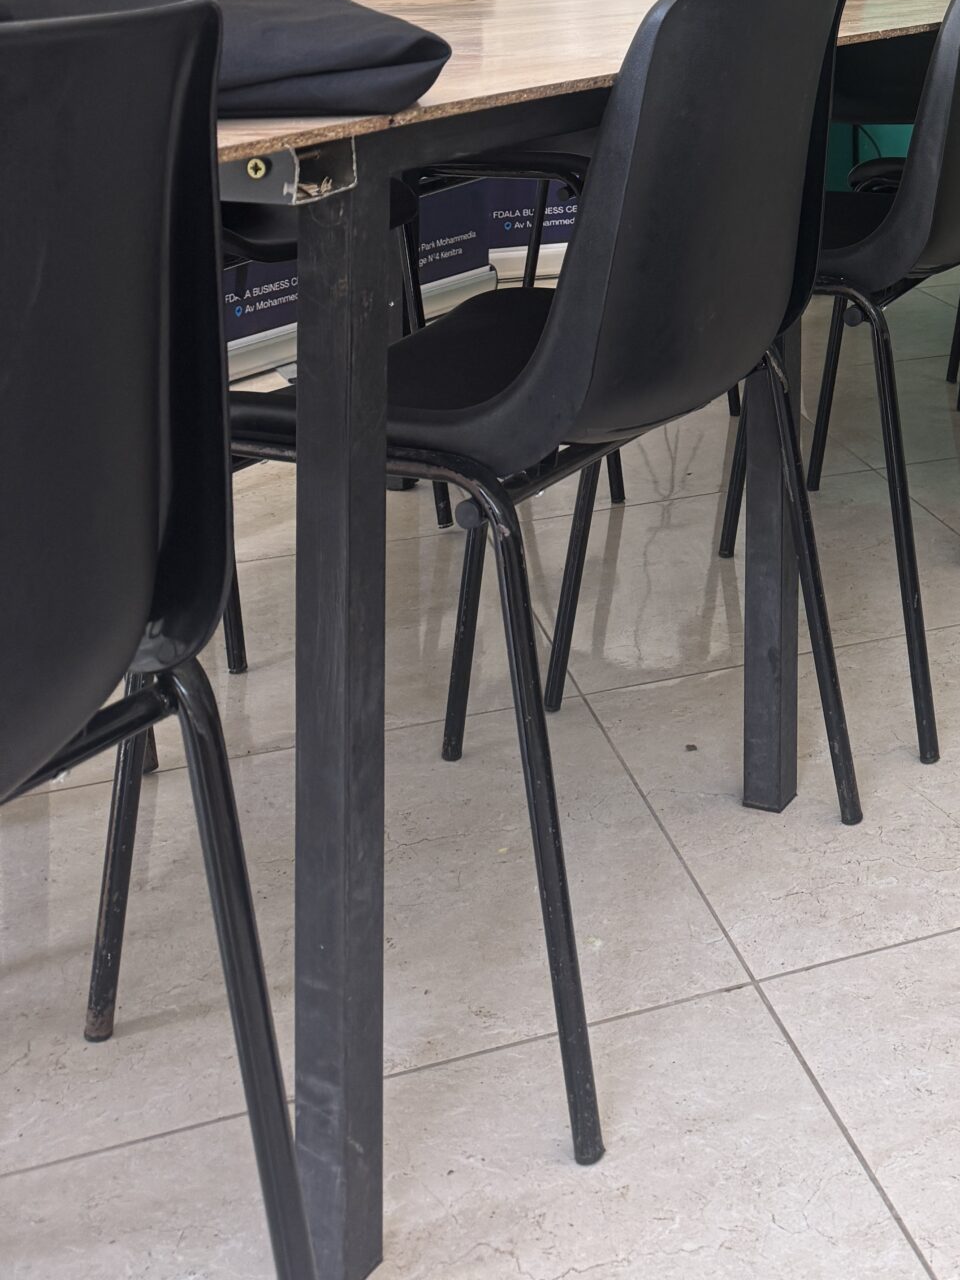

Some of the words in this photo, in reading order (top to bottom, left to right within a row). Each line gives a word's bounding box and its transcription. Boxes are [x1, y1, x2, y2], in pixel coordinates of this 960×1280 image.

[514, 221, 525, 229] Av
[421, 241, 436, 252] Park
[252, 279, 290, 297] BUSINESS
[244, 304, 255, 314] Av
